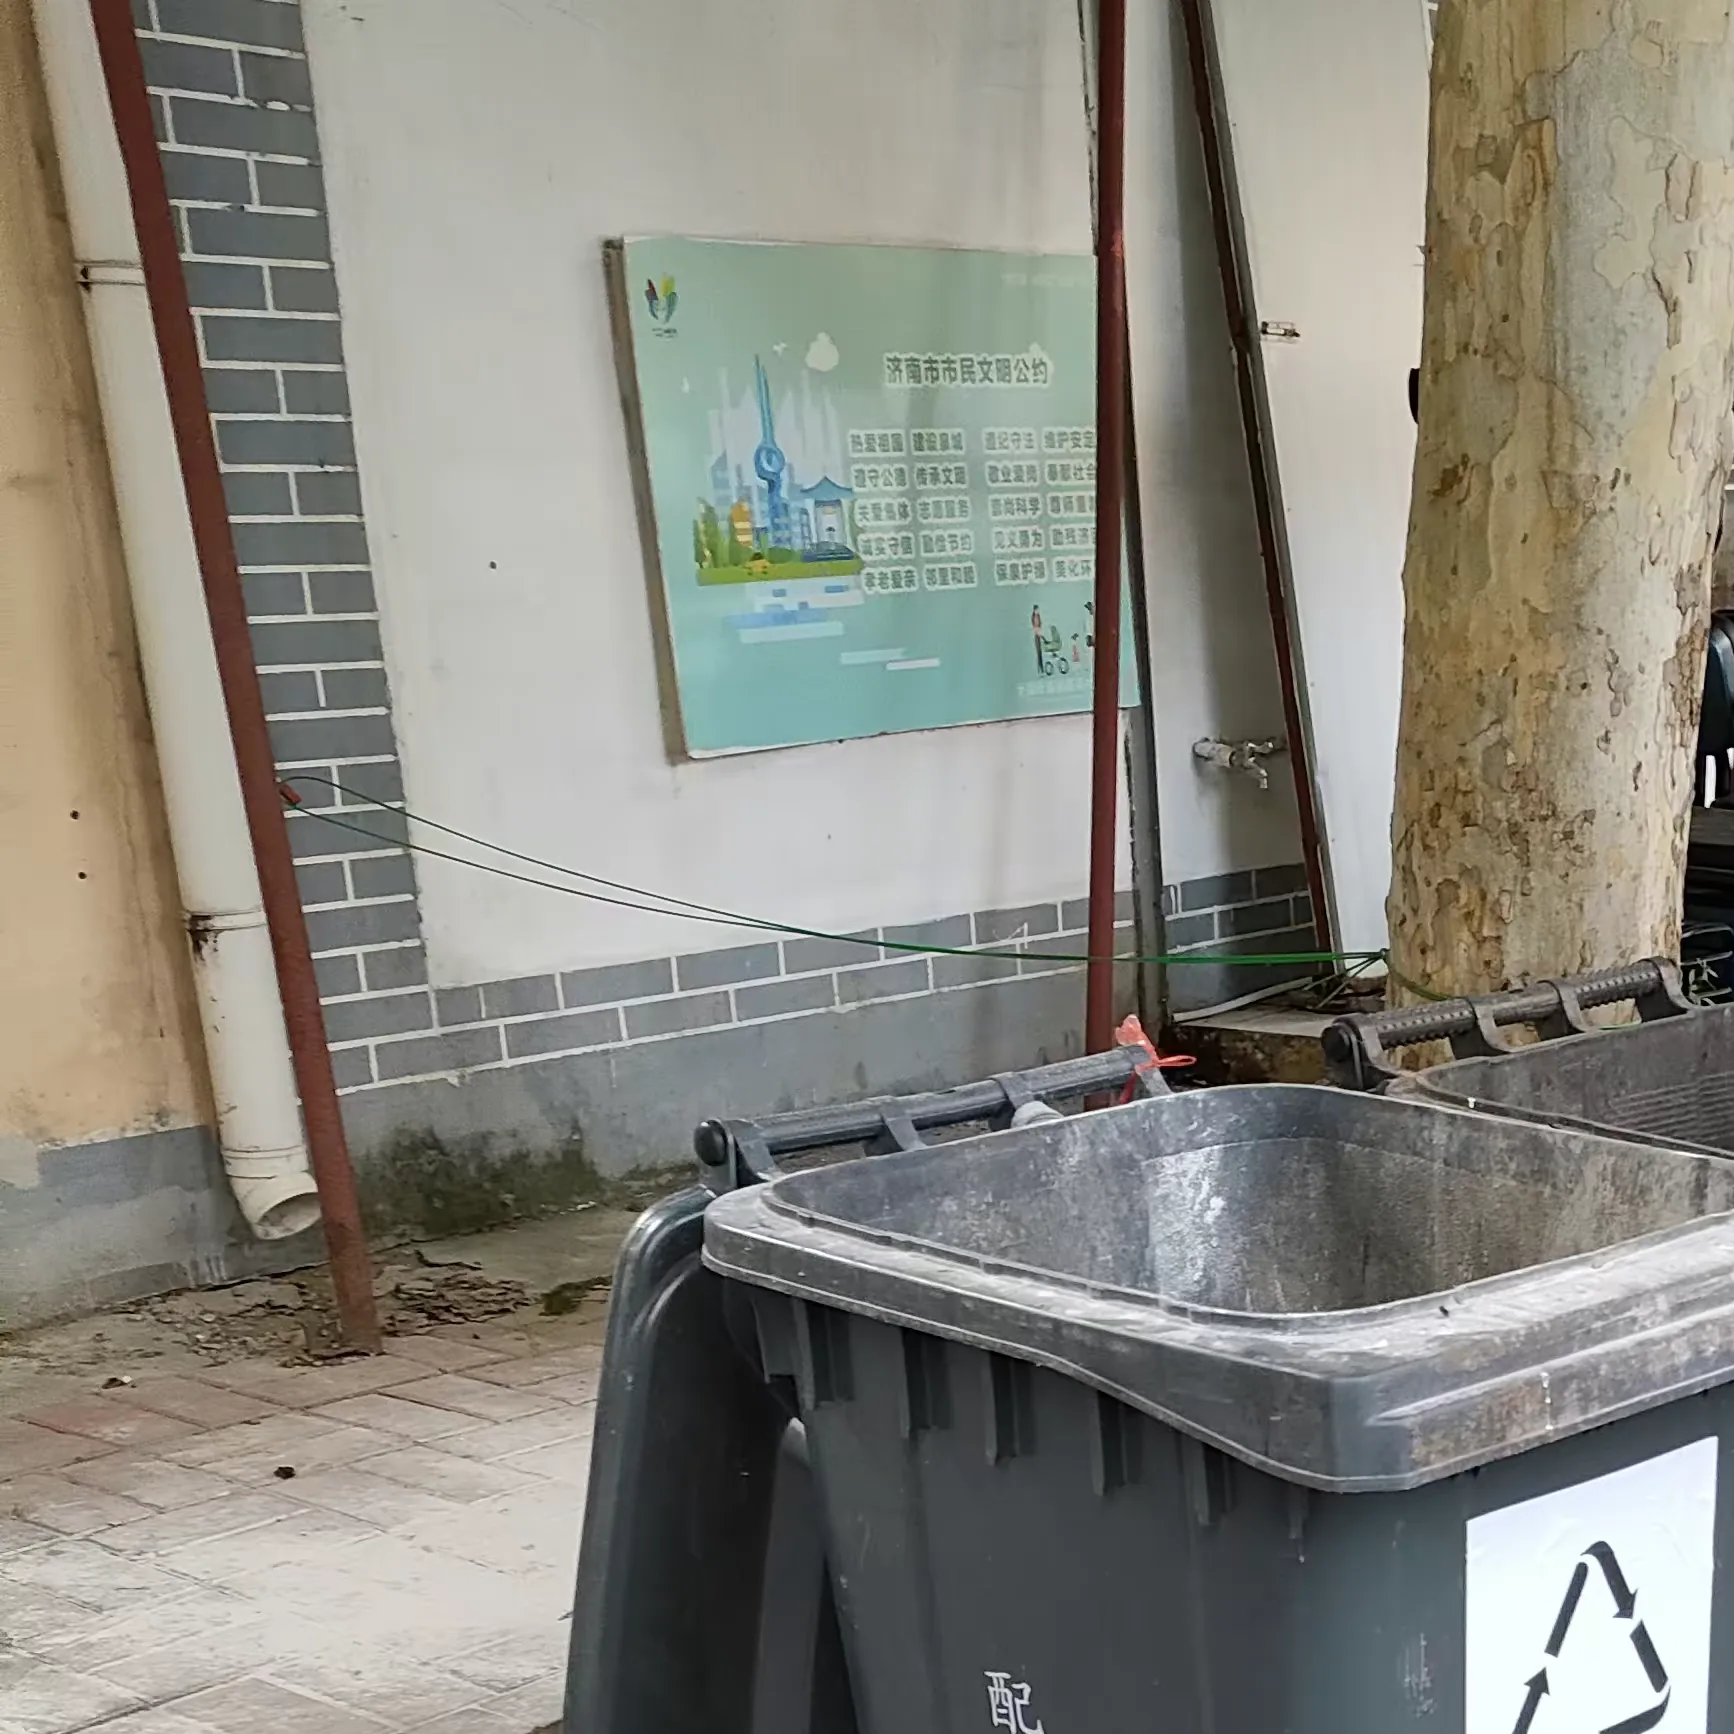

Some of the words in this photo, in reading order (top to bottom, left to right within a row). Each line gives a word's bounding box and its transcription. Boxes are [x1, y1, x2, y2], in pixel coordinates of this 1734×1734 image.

[886, 356, 1048, 384] 济南市市民文明公约
